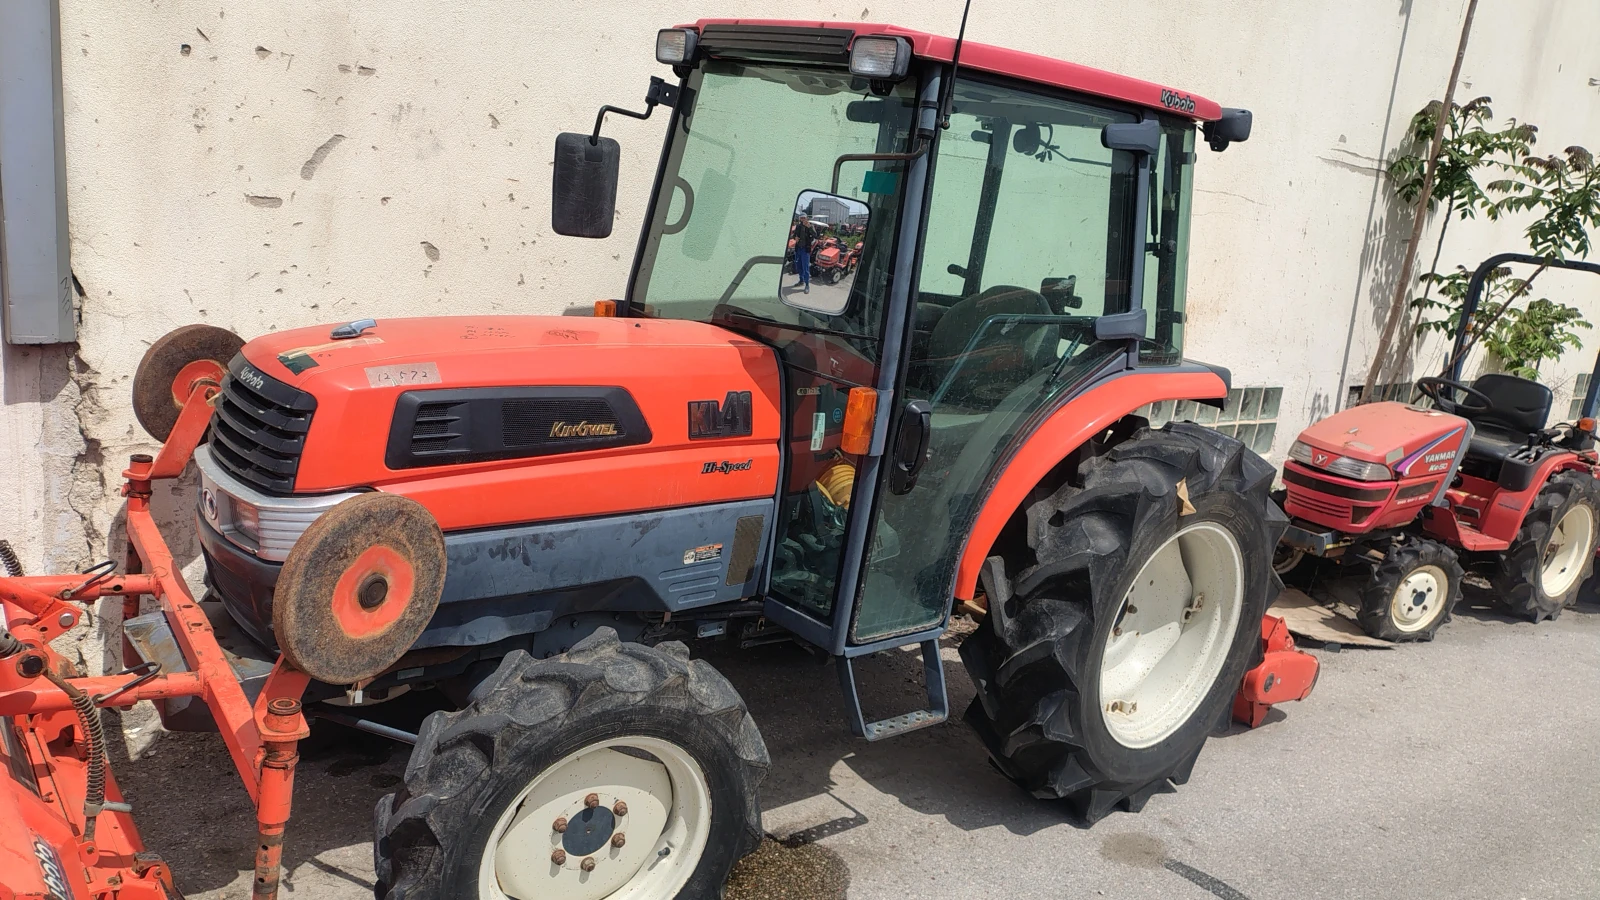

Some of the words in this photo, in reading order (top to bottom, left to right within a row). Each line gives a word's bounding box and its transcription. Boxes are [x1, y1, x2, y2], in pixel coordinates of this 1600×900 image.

[1161, 89, 1195, 113] Kubota
[240, 366, 264, 389] Kubota
[688, 391, 752, 441] KL41
[701, 458, 753, 474] Hi-Speed
[1425, 450, 1456, 463] YANMAR
